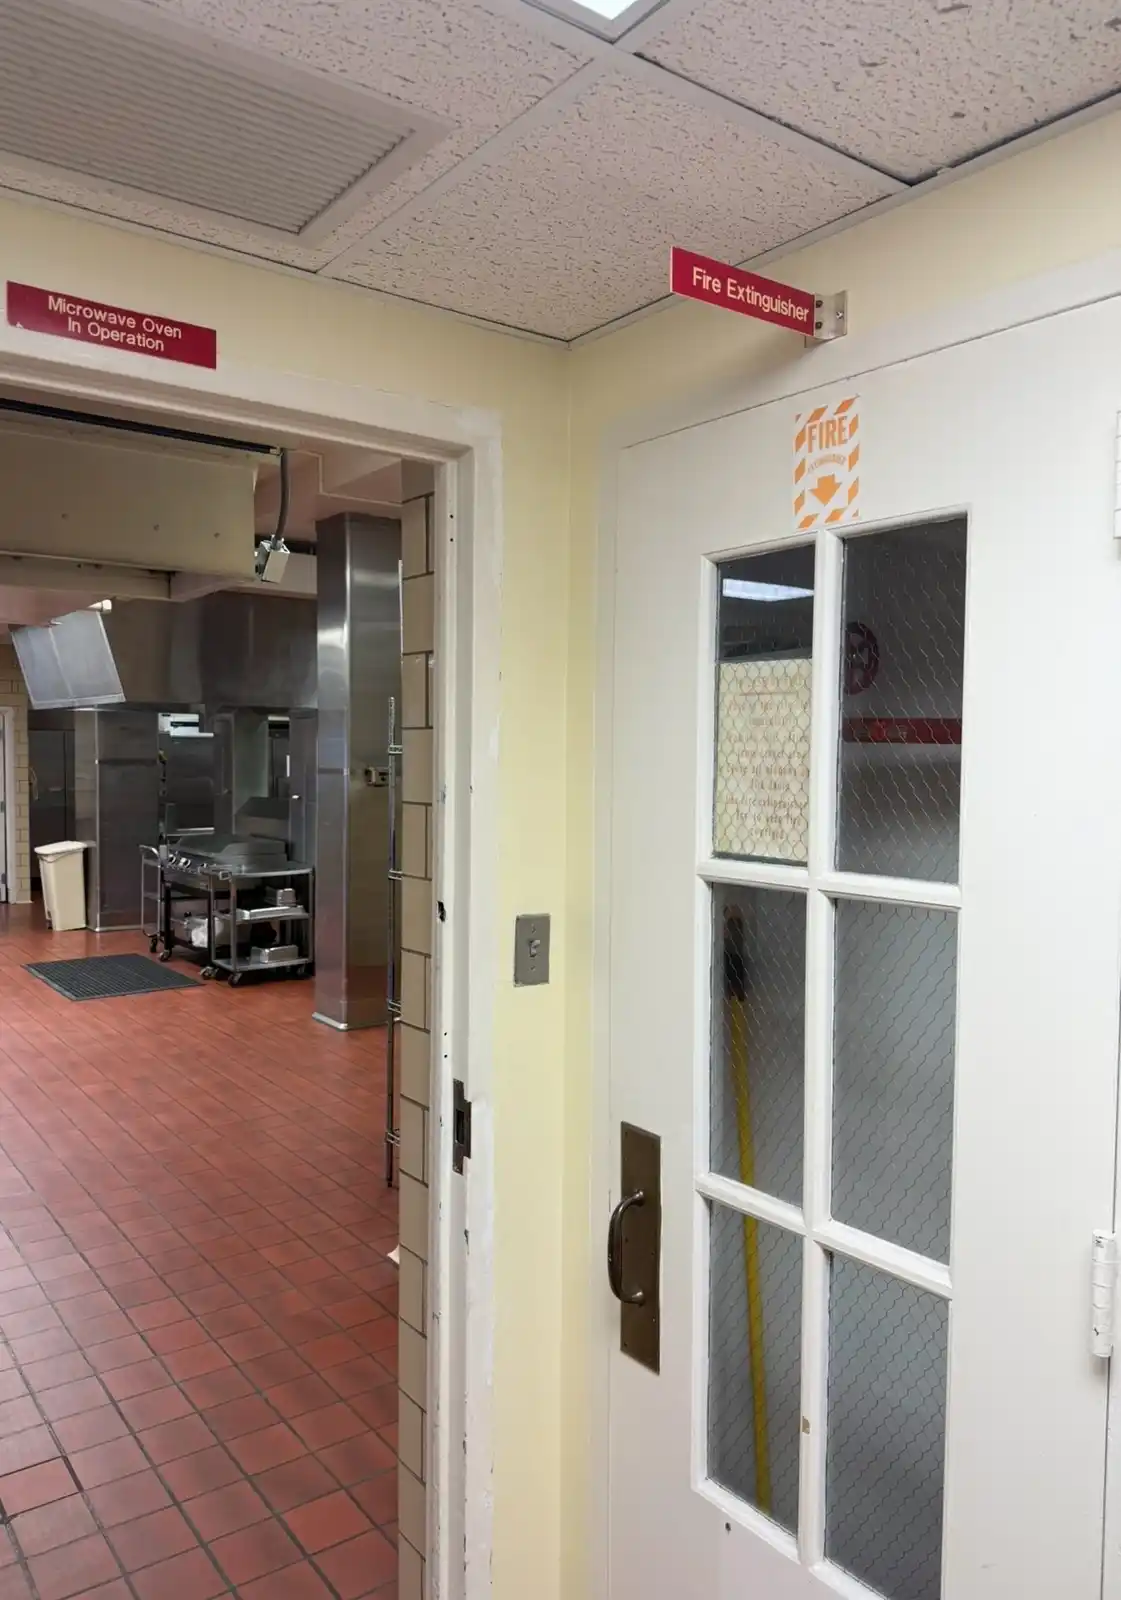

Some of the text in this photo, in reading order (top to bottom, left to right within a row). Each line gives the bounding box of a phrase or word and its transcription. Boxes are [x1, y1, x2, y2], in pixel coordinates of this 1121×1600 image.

[692, 266, 809, 322] Fire Extinguisher
[48, 295, 182, 339] Microwave Oven
[68, 317, 164, 352] In Operation
[808, 416, 848, 453] FIRE
